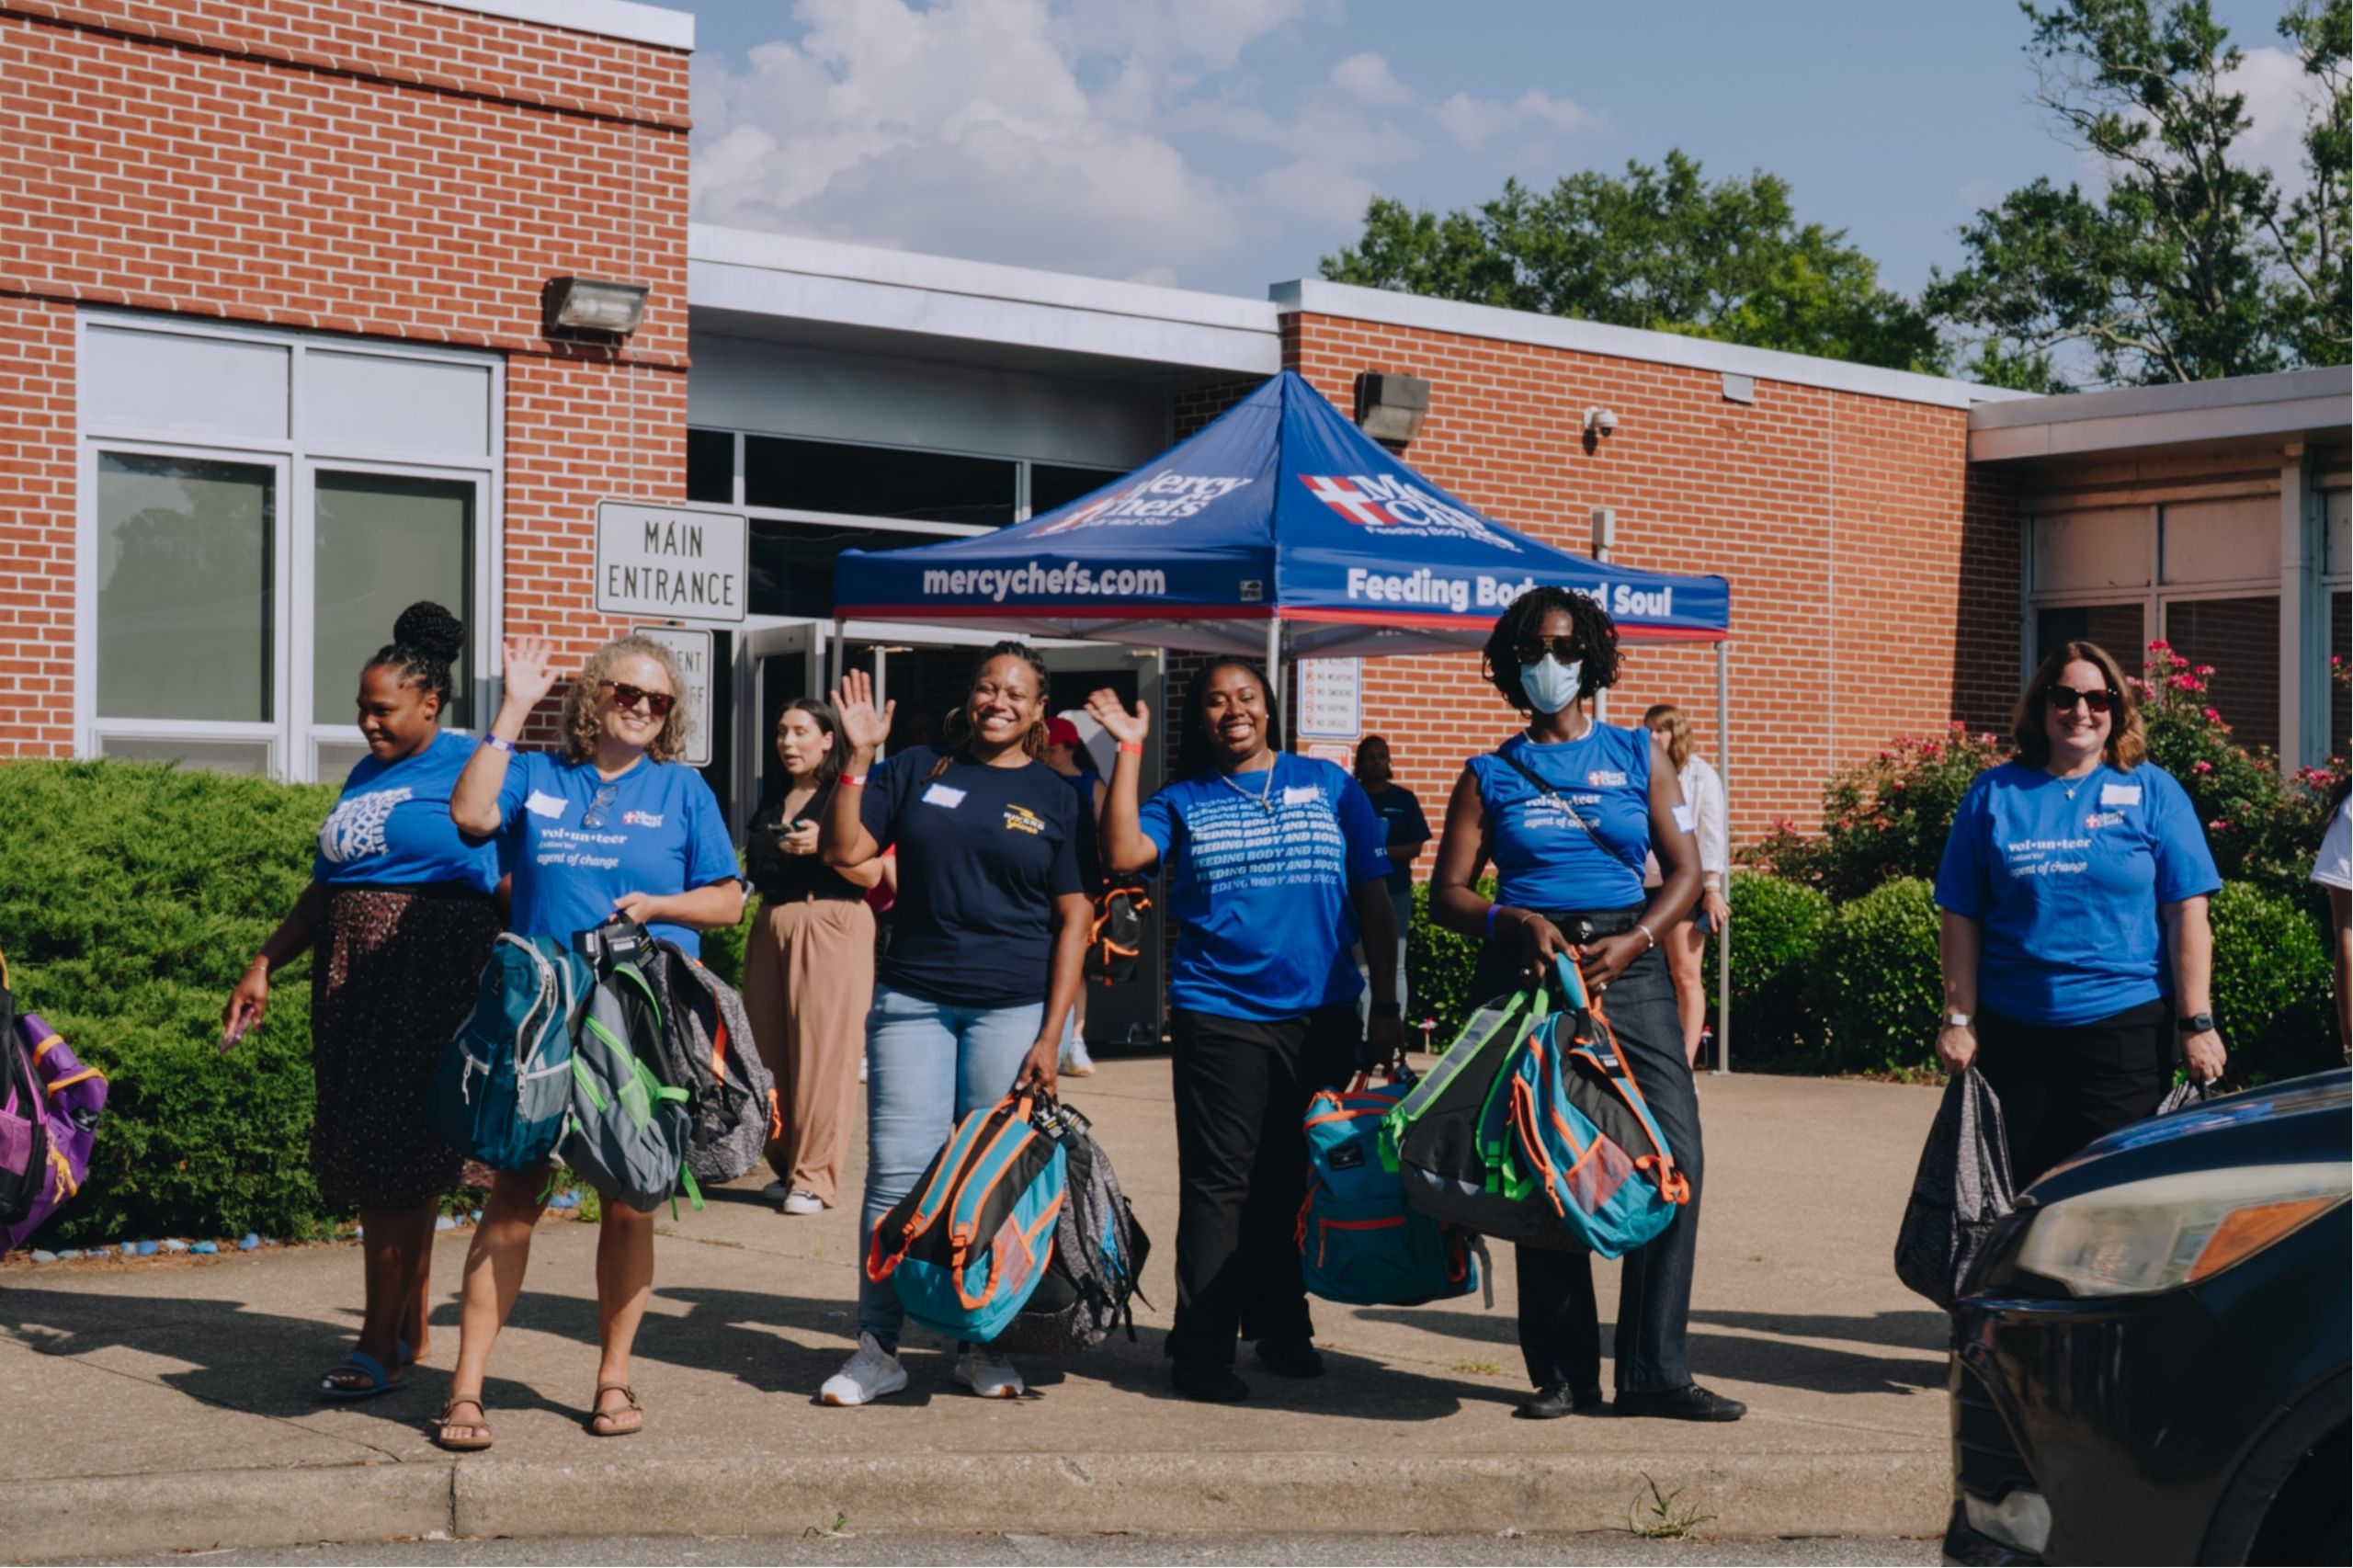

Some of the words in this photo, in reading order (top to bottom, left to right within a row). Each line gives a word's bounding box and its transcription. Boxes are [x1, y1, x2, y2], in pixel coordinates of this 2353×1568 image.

[644, 521, 702, 558] MAIN
[608, 564, 733, 606] ENTRANCE
[923, 561, 1165, 602] mercychefs.com
[1347, 567, 1469, 612] Feeding
[1476, 575, 1537, 608] Bo
[1613, 585, 1673, 617] Soul
[1244, 824, 1281, 837] BODY
[1281, 820, 1309, 833] AND
[1309, 820, 1339, 833] SOUL
[1524, 817, 1554, 828] agent
[1556, 817, 1567, 829] of
[1191, 839, 1244, 856] FEEDING
[1245, 835, 1283, 848] BODY
[1282, 831, 1311, 844] AND
[1312, 831, 1341, 845] SOUL
[537, 853, 565, 866] agent
[567, 853, 580, 867] of
[580, 854, 620, 870] change
[1246, 847, 1285, 861] BODY
[1285, 845, 1312, 858] AND
[1313, 845, 1341, 858] SOUL
[1249, 861, 1286, 874] BODY
[1285, 858, 1313, 871] AND
[2038, 862, 2049, 876] of
[2051, 860, 2088, 874] change
[1286, 873, 1313, 884] AND
